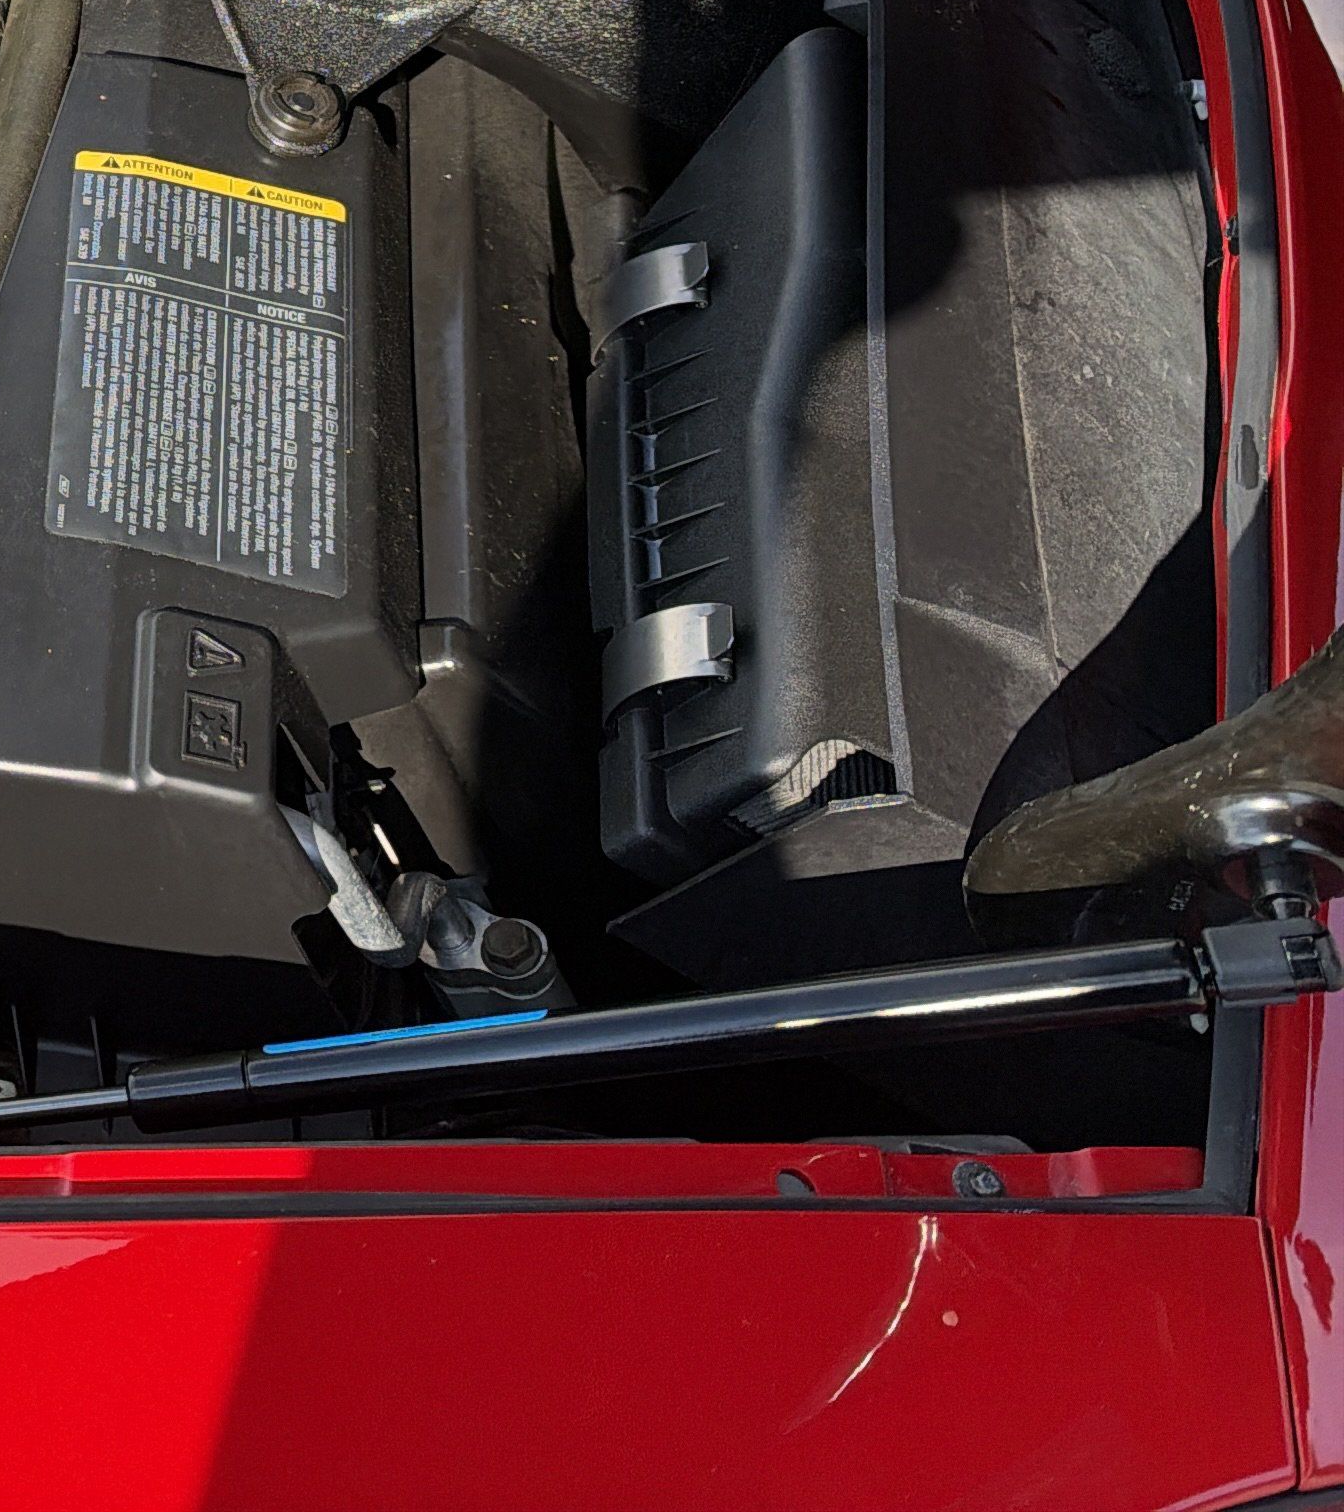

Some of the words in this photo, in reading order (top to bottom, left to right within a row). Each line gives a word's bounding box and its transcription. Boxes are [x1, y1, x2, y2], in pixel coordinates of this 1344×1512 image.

[123, 157, 194, 181] ATTENTION
[266, 189, 323, 211] CAUTION
[125, 272, 157, 288] AVIS
[312, 257, 323, 295] PRESSURE
[326, 244, 336, 292] REFRIGERANT
[257, 304, 307, 323] NOTICE
[284, 328, 296, 361] SPECIAL
[324, 337, 336, 352] AIR
[270, 364, 282, 379] GM
[297, 375, 309, 387] kg
[324, 350, 336, 404] CONDITIONING
[269, 377, 281, 411] Standard
[283, 386, 296, 401] OIL
[310, 377, 322, 401] Glycol
[282, 400, 295, 440] REQUIRED
[310, 444, 322, 461] The
[324, 434, 336, 450] Use
[268, 450, 280, 474] Using
[281, 469, 294, 488] This
[323, 466, 336, 497] R-134a
[238, 517, 251, 556] American
[280, 513, 294, 548] requires
[266, 535, 278, 553] can
[309, 537, 321, 570] System
[323, 537, 336, 555] and
[266, 551, 278, 577] cause
